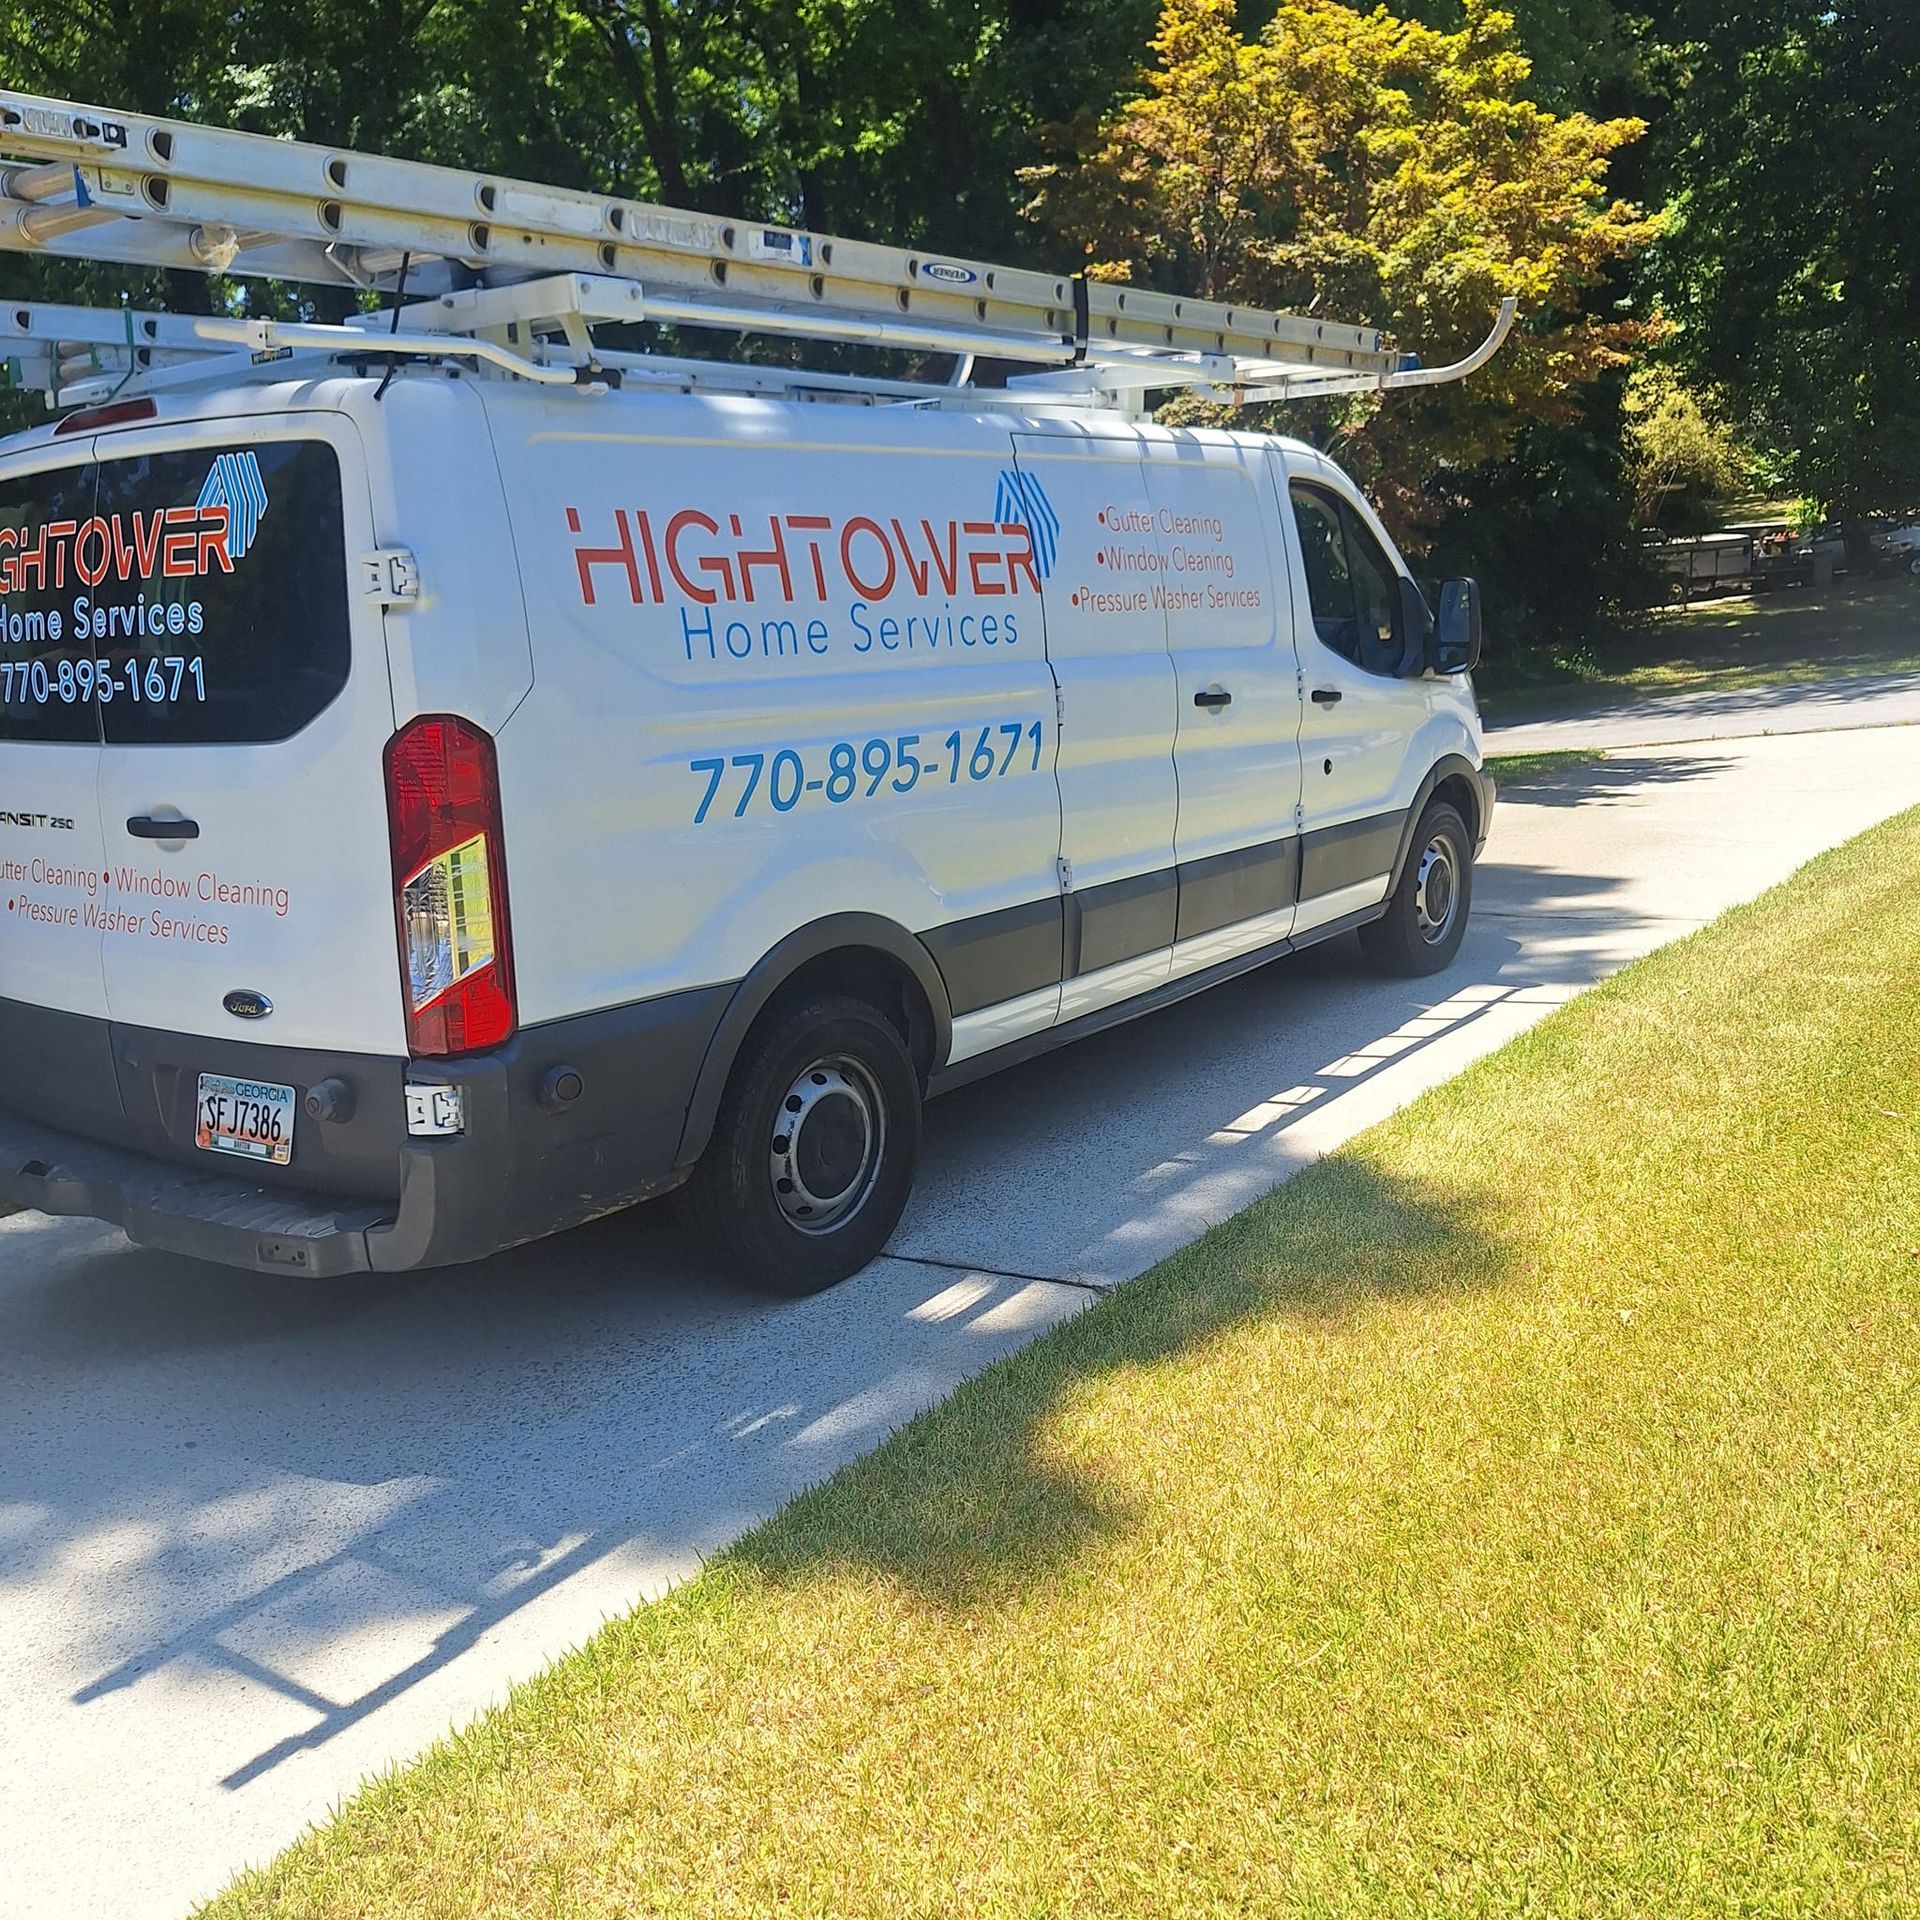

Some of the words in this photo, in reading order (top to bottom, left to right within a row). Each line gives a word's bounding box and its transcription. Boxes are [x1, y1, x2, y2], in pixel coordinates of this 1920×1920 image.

[1105, 505, 1156, 533] Gutter
[1159, 508, 1222, 541] Cleaning
[565, 507, 1042, 605] HIGHTOWER
[1104, 546, 1169, 572] Window
[1172, 547, 1234, 578] Cleaning
[73, 593, 204, 640] Services
[1080, 586, 1147, 613] Pressure
[1150, 584, 1204, 610] Washer
[1207, 584, 1261, 609] Services
[681, 606, 829, 660] Home
[850, 603, 1018, 652] Services
[0, 656, 206, 703] 770-895-1671
[690, 720, 1042, 825] 770-895-1671
[31, 858, 98, 897] Cleaning
[114, 866, 192, 899] Window
[197, 873, 289, 917] Cleaning
[18, 895, 79, 926] Pressure
[83, 902, 146, 934] Washer
[150, 909, 230, 945] Services
[231, 1002, 258, 1014] Ford
[235, 1082, 288, 1103] GEORGIA
